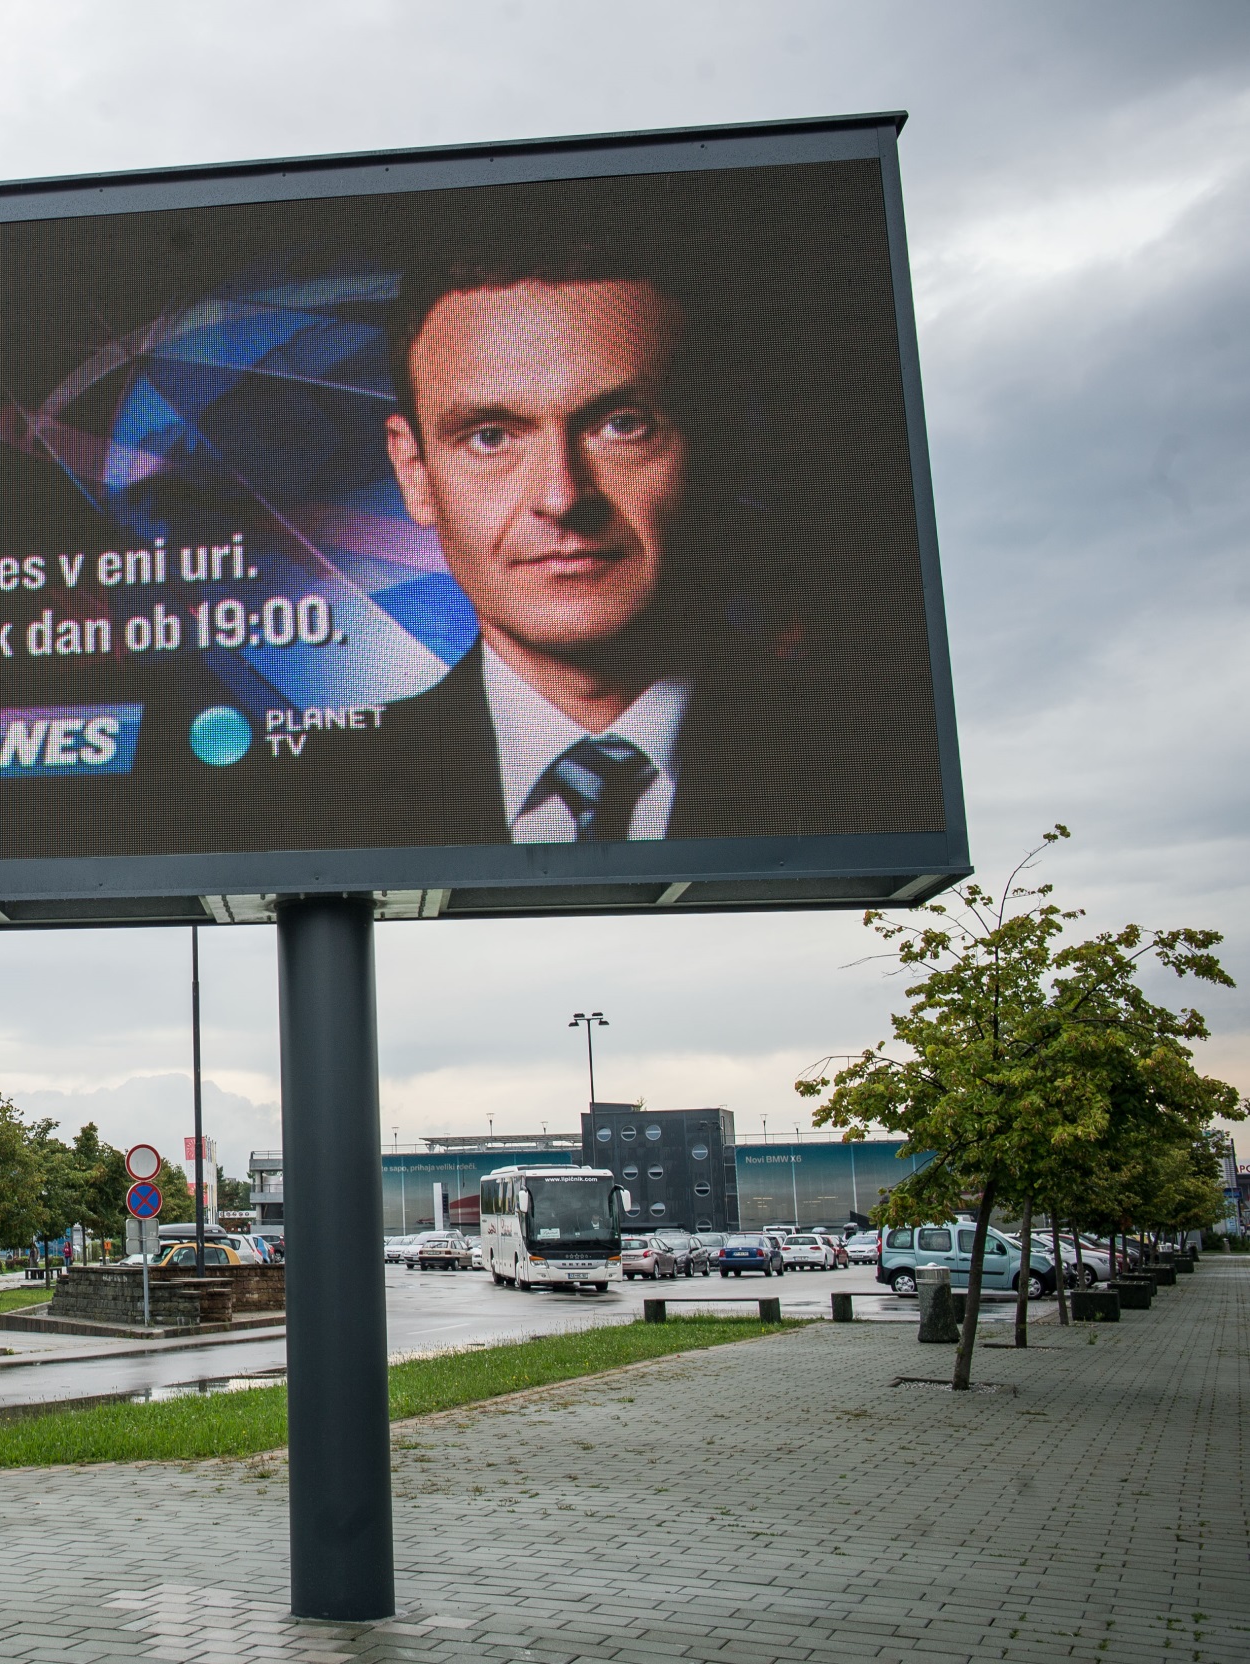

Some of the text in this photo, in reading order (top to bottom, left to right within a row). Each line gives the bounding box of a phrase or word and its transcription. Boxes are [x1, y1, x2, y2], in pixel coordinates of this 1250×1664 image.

[58, 553, 84, 588] v
[98, 537, 166, 587] eni
[180, 532, 258, 582] uri.
[26, 608, 111, 655] dan
[125, 603, 181, 652] ob
[192, 595, 347, 649] 19:00.
[266, 704, 387, 732] PLANET
[265, 733, 307, 757] TV
[410, 1163, 435, 1172] prihaja
[436, 1163, 455, 1171] veliki
[745, 1154, 802, 1164] Novi BMW X6
